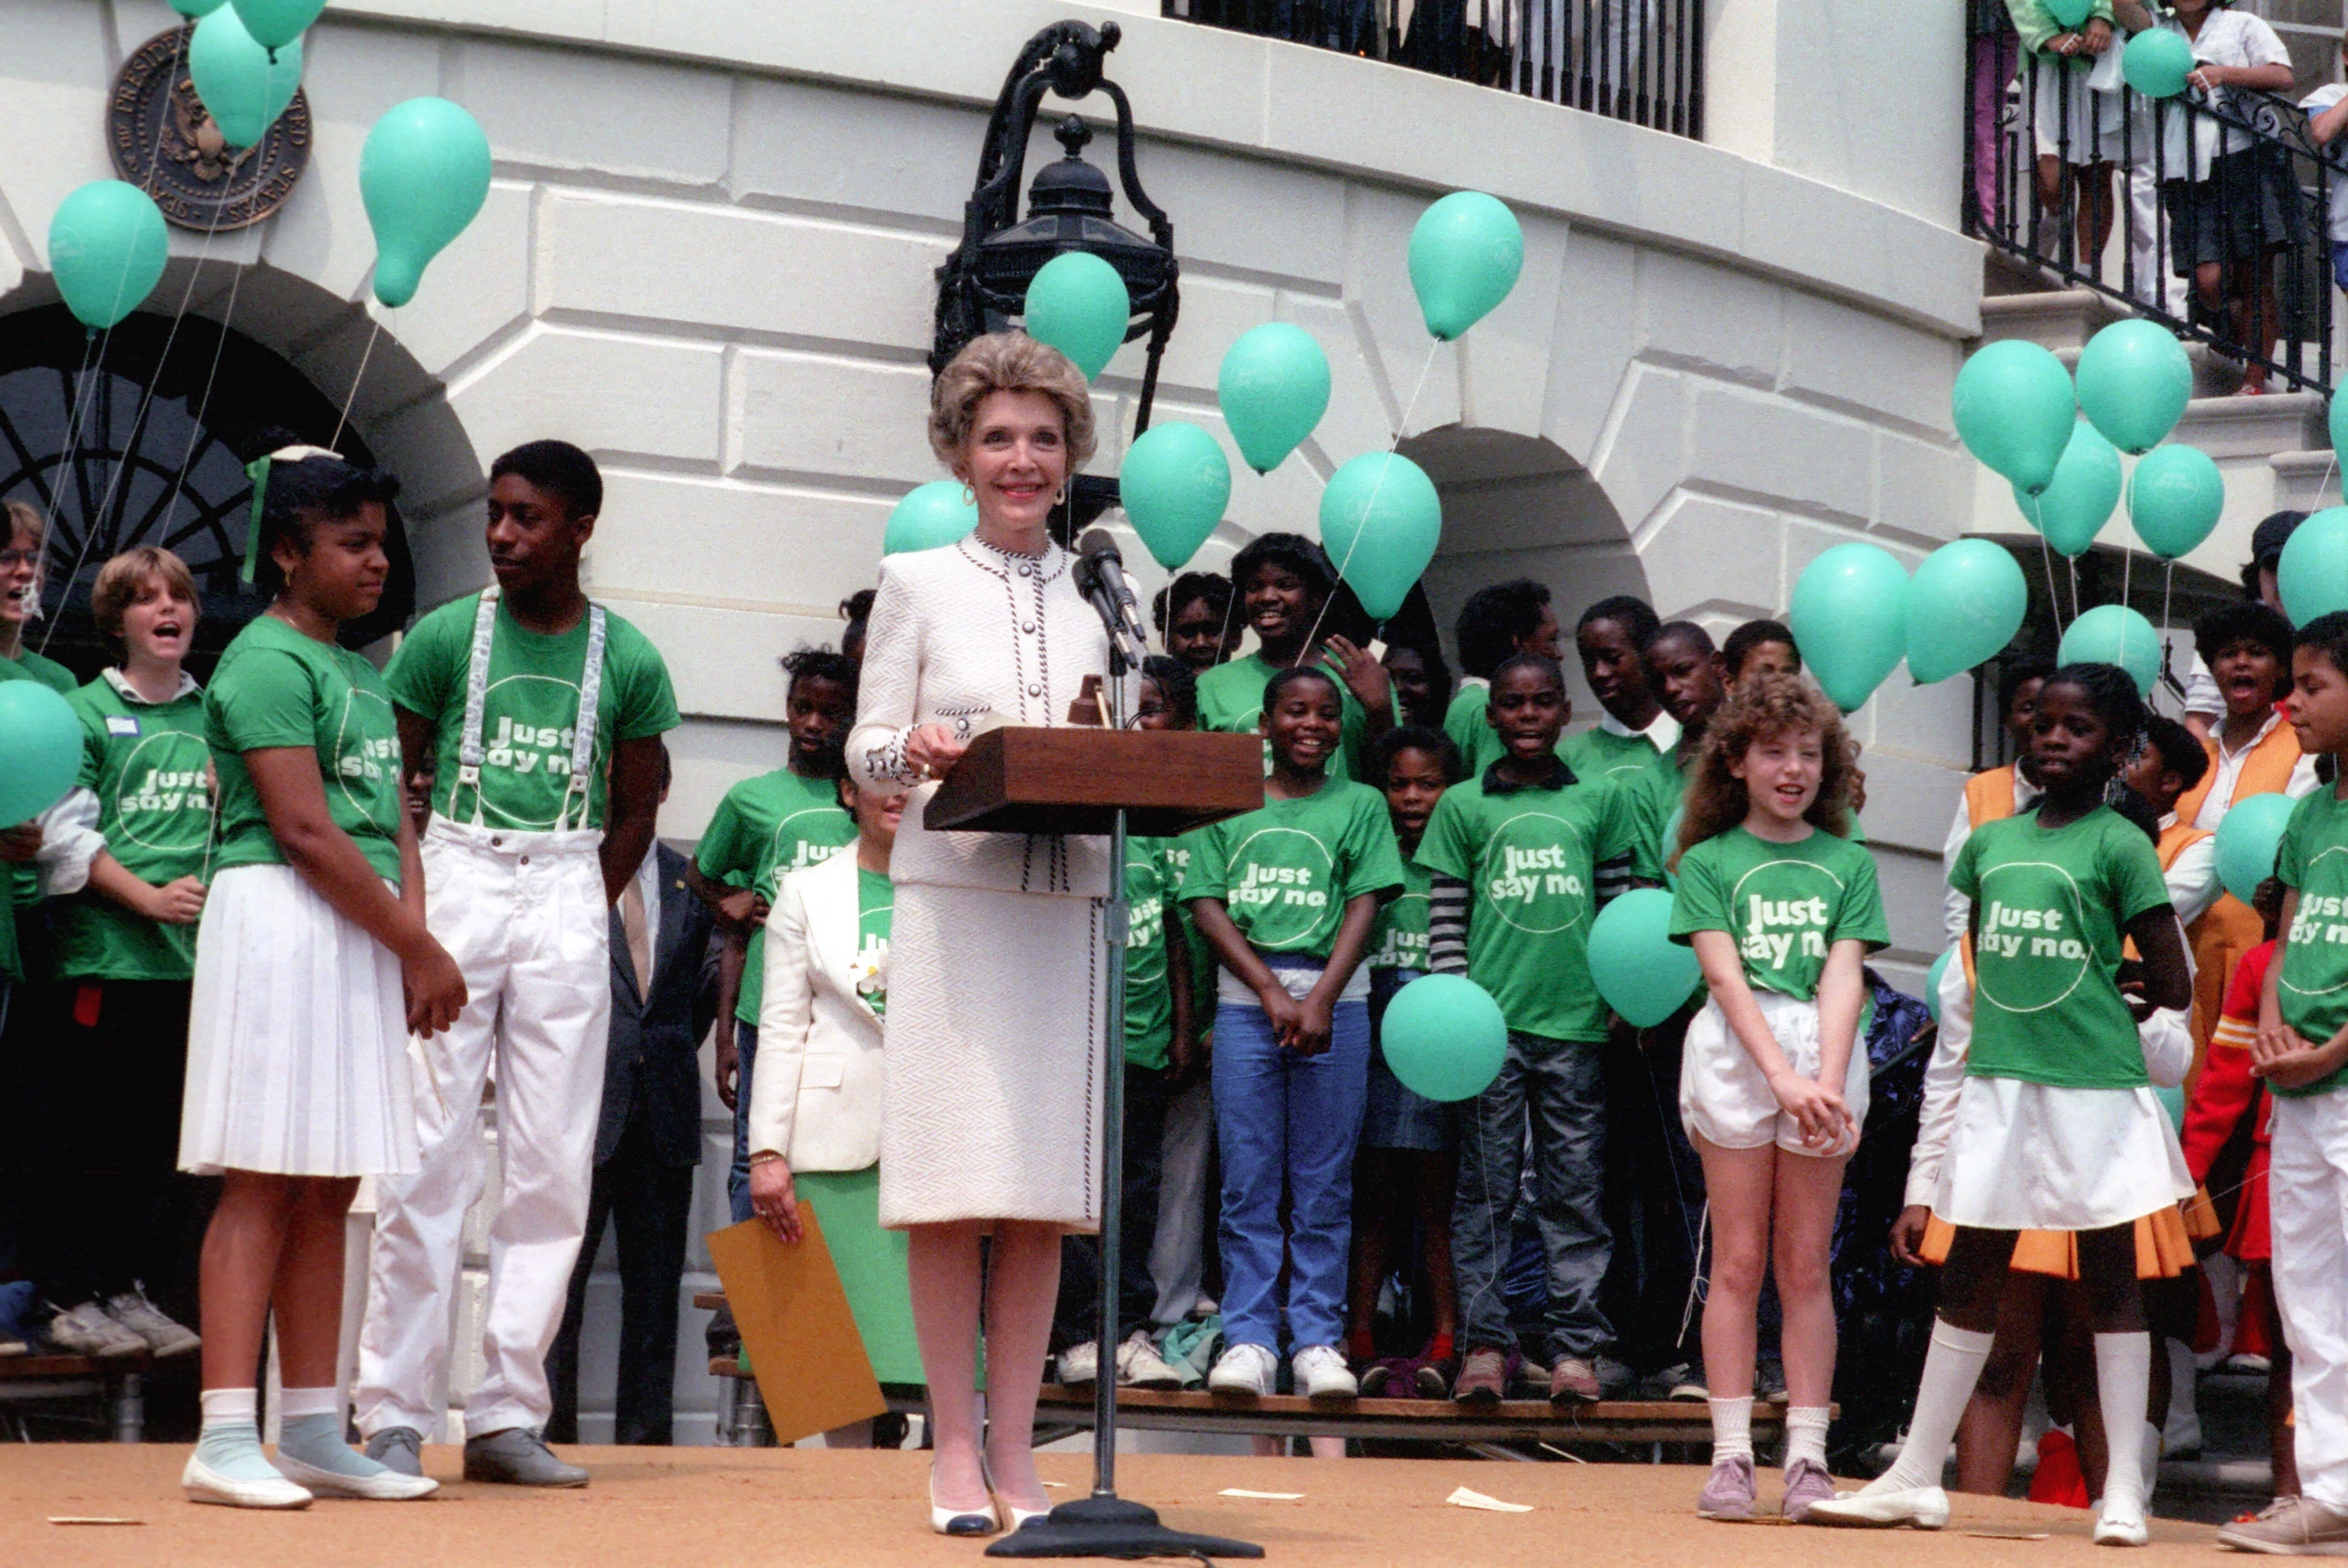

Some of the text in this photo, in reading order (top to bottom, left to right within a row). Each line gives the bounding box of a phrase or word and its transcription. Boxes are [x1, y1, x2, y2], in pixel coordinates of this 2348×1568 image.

[116, 32, 191, 112] PRESIDEN
[227, 162, 296, 222] STATES
[491, 716, 573, 749] Just
[479, 748, 539, 773] ay
[140, 769, 207, 795] Just
[120, 793, 182, 812] say
[1504, 844, 1567, 878] Just
[1240, 863, 1312, 888] Just
[1228, 888, 1279, 904] say
[1492, 874, 1541, 904] say
[1129, 898, 1162, 925] ust
[1746, 894, 1829, 935] Just
[1984, 901, 2063, 934] Just
[1380, 928, 1429, 953] Jus
[2288, 922, 2322, 944] ay
